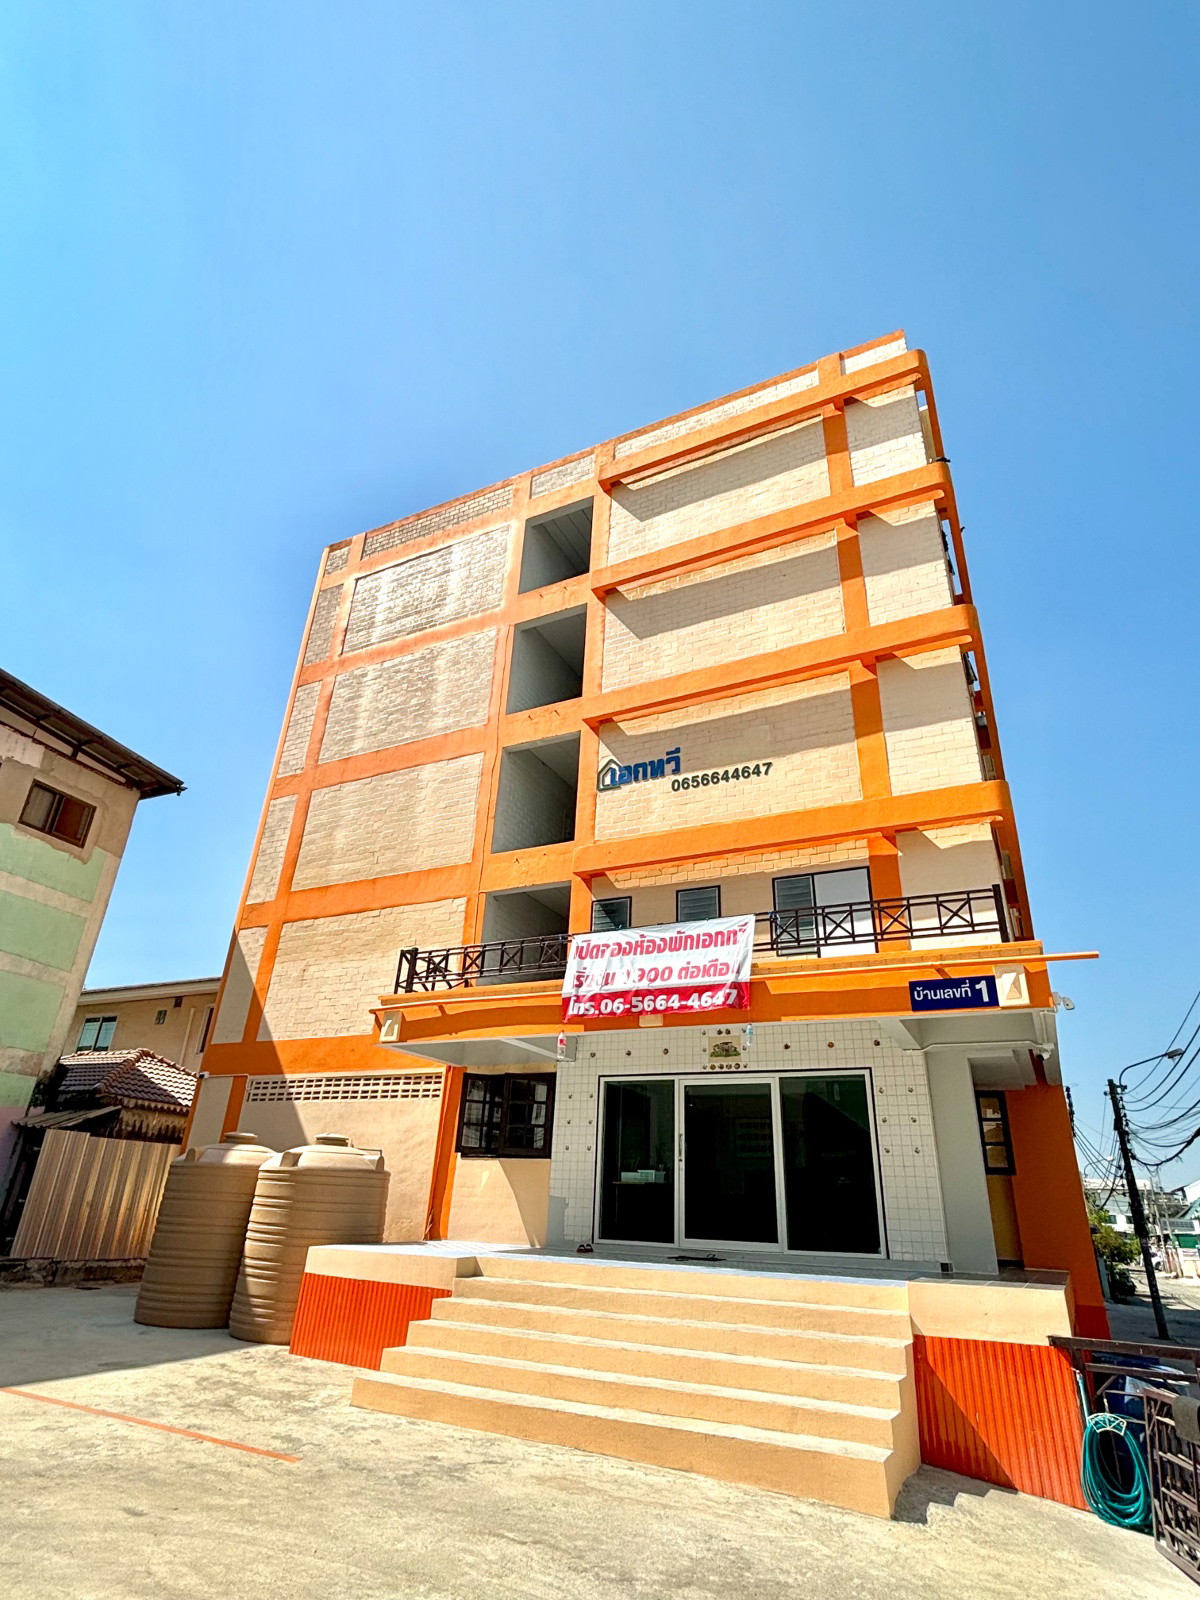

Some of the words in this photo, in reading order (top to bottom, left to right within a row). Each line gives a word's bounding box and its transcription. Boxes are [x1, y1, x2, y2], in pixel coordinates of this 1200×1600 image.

[609, 747, 681, 786] เอกทวี
[671, 762, 773, 792] 0656644647
[914, 980, 972, 1001] บ้านเลขที่
[975, 980, 990, 1002] 1
